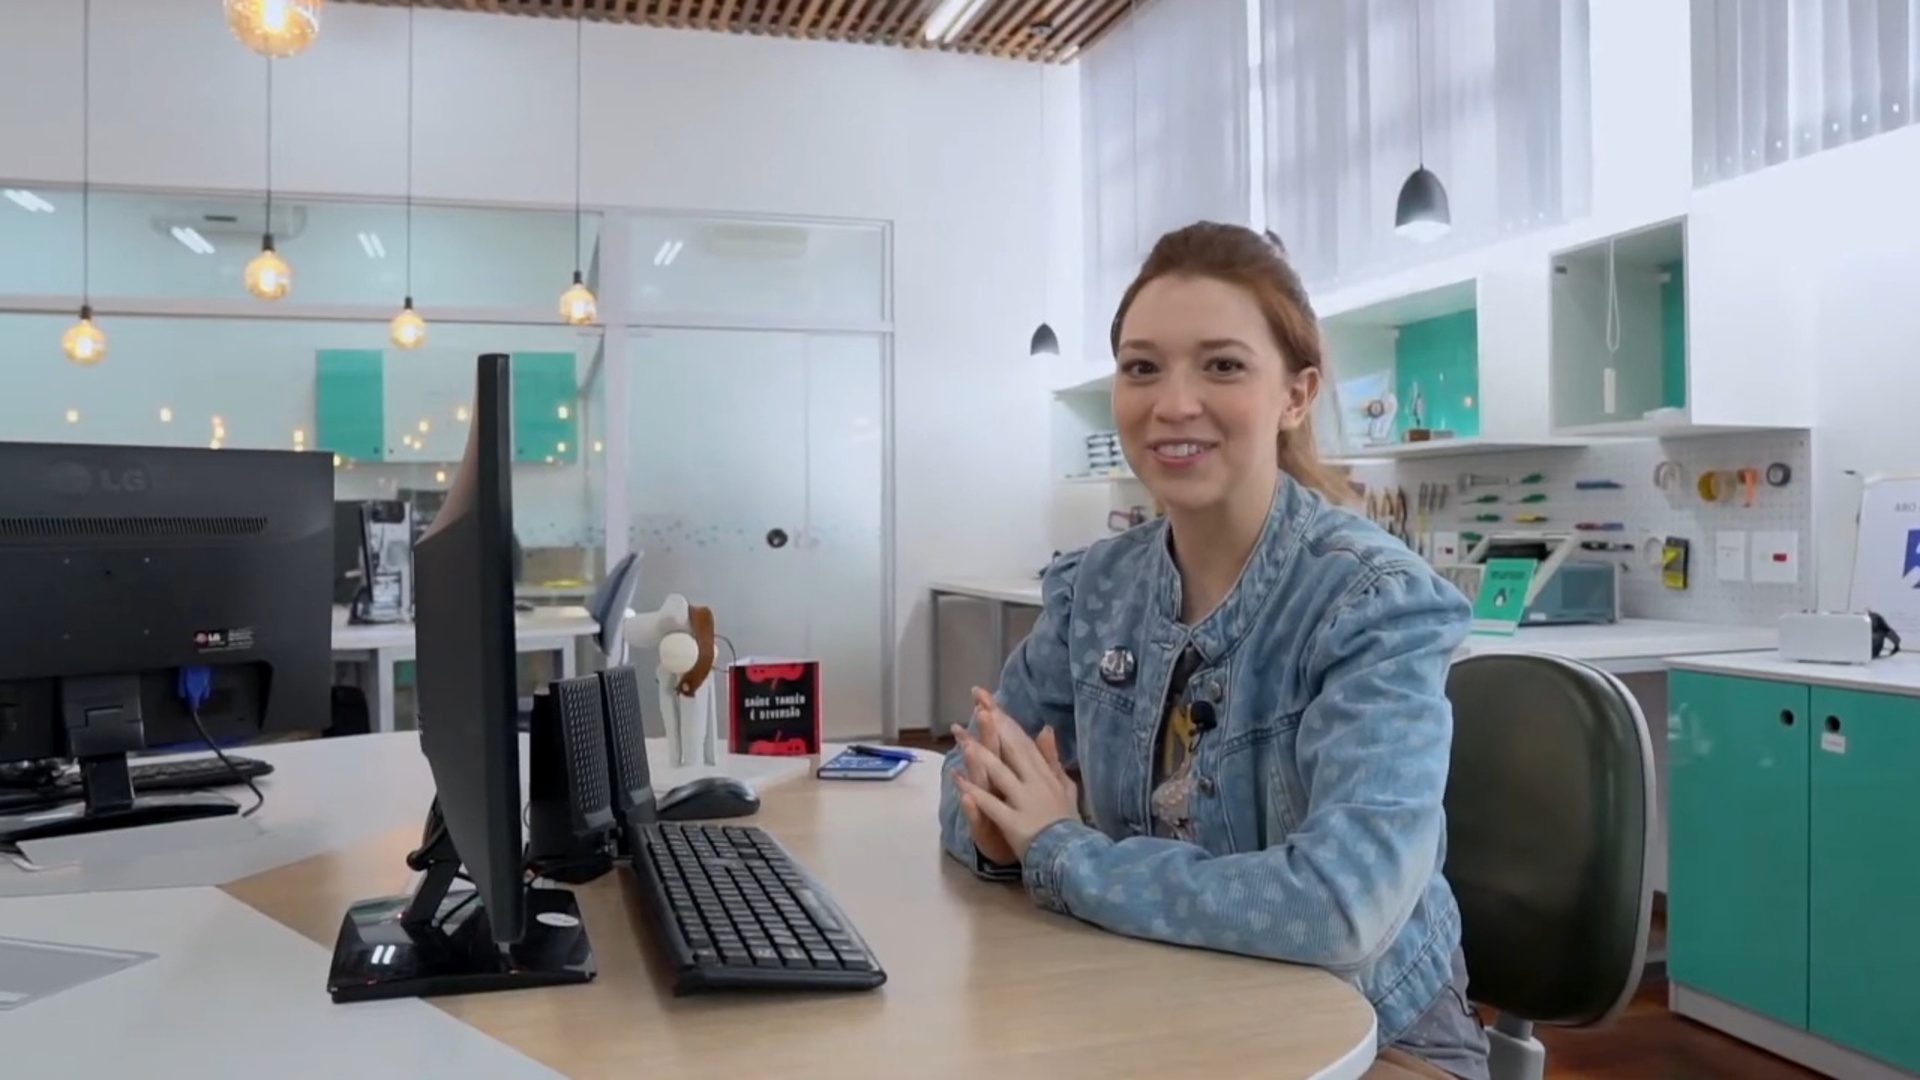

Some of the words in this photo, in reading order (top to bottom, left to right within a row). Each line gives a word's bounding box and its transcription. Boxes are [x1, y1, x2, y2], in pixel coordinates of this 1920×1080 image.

[100, 468, 148, 492] LG
[744, 695, 770, 707] SAÚDE
[750, 708, 756, 720] É
[759, 706, 801, 720] DIVERSÃO
